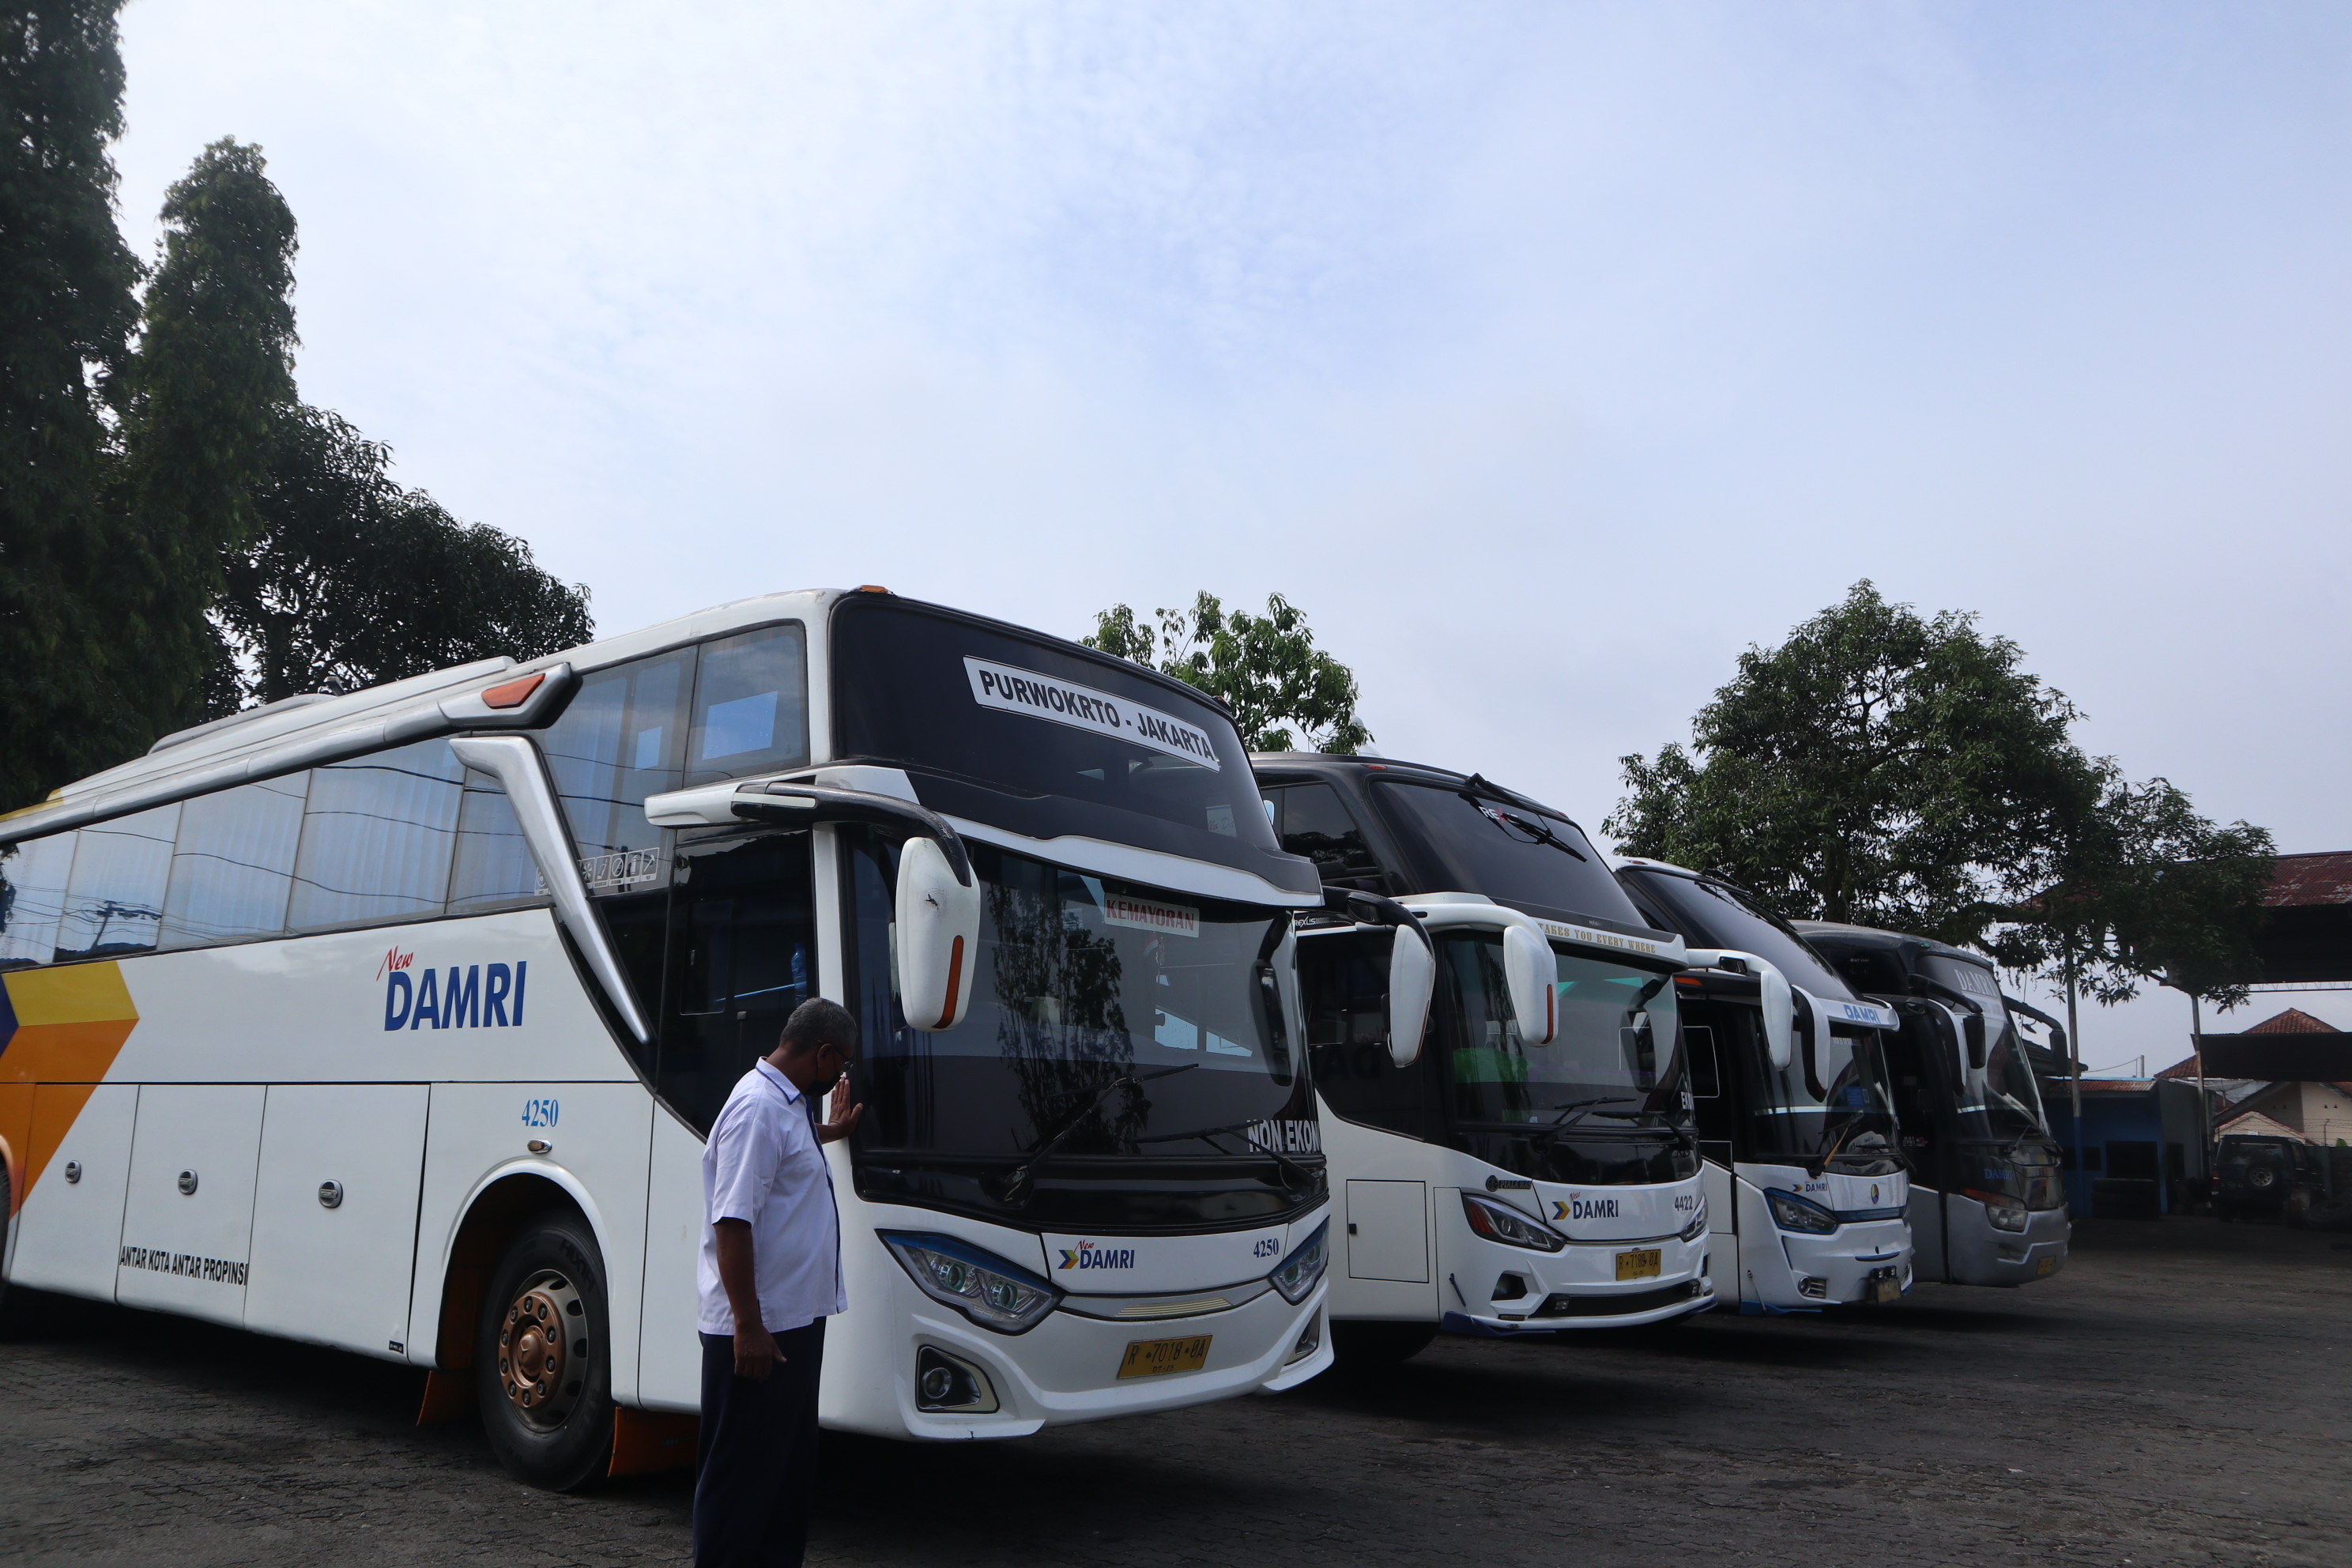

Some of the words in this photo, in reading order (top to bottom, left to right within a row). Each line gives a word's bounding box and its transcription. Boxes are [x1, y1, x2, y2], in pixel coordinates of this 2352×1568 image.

[978, 669, 1121, 728] PURWOKRTO
[1136, 712, 1216, 762] JAKARTA
[1106, 899, 1194, 931] KEMAYORAN
[1538, 923, 1570, 937] TAKES
[1574, 929, 1592, 941] YOU
[1596, 933, 1624, 948] EVERY
[1628, 940, 1656, 954] WHERE
[376, 945, 413, 981] New
[384, 960, 527, 1031] DAMRI
[1954, 969, 1997, 997] DAMRI
[1843, 1004, 1881, 1024] DAMRI
[521, 1099, 559, 1127] 4250
[1246, 1119, 1283, 1153] NON
[1285, 1119, 1320, 1152] EKON
[1806, 1182, 1827, 1192] DAMRI
[1984, 1168, 2013, 1181] DAMRI
[1573, 1199, 1619, 1219] DAMRI
[1675, 1195, 1693, 1212] 4422
[1073, 1239, 1095, 1253] New
[1080, 1250, 1135, 1269] DAMRI
[1253, 1238, 1280, 1258] 4250
[119, 1246, 146, 1269] ANTAR
[148, 1249, 170, 1274] KOTA
[171, 1253, 202, 1280] ANTAR
[202, 1257, 249, 1287] PROPINSI
